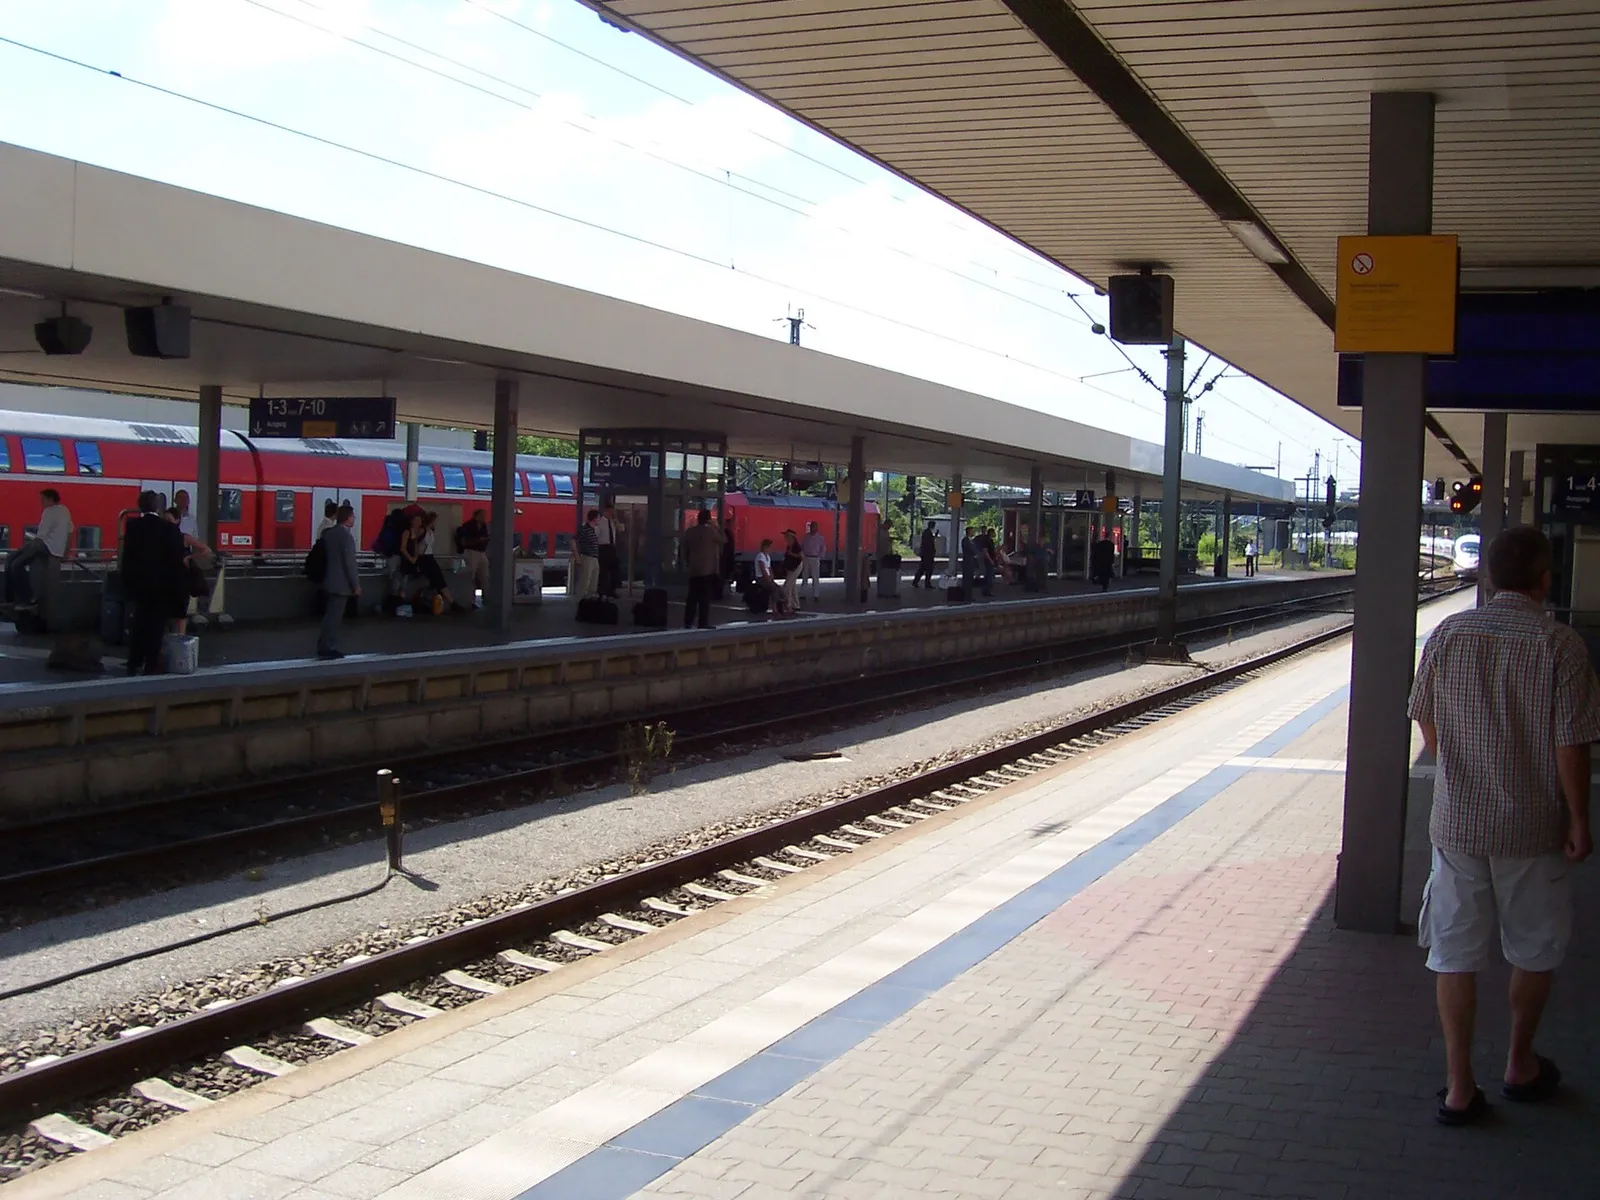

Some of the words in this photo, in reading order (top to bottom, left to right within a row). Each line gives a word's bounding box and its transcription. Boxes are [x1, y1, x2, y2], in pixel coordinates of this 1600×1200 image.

[267, 399, 288, 416] 1-3
[298, 399, 326, 416] 7-10
[594, 455, 611, 467] 1-3
[619, 455, 641, 468] 7-10
[1080, 491, 1091, 505] A
